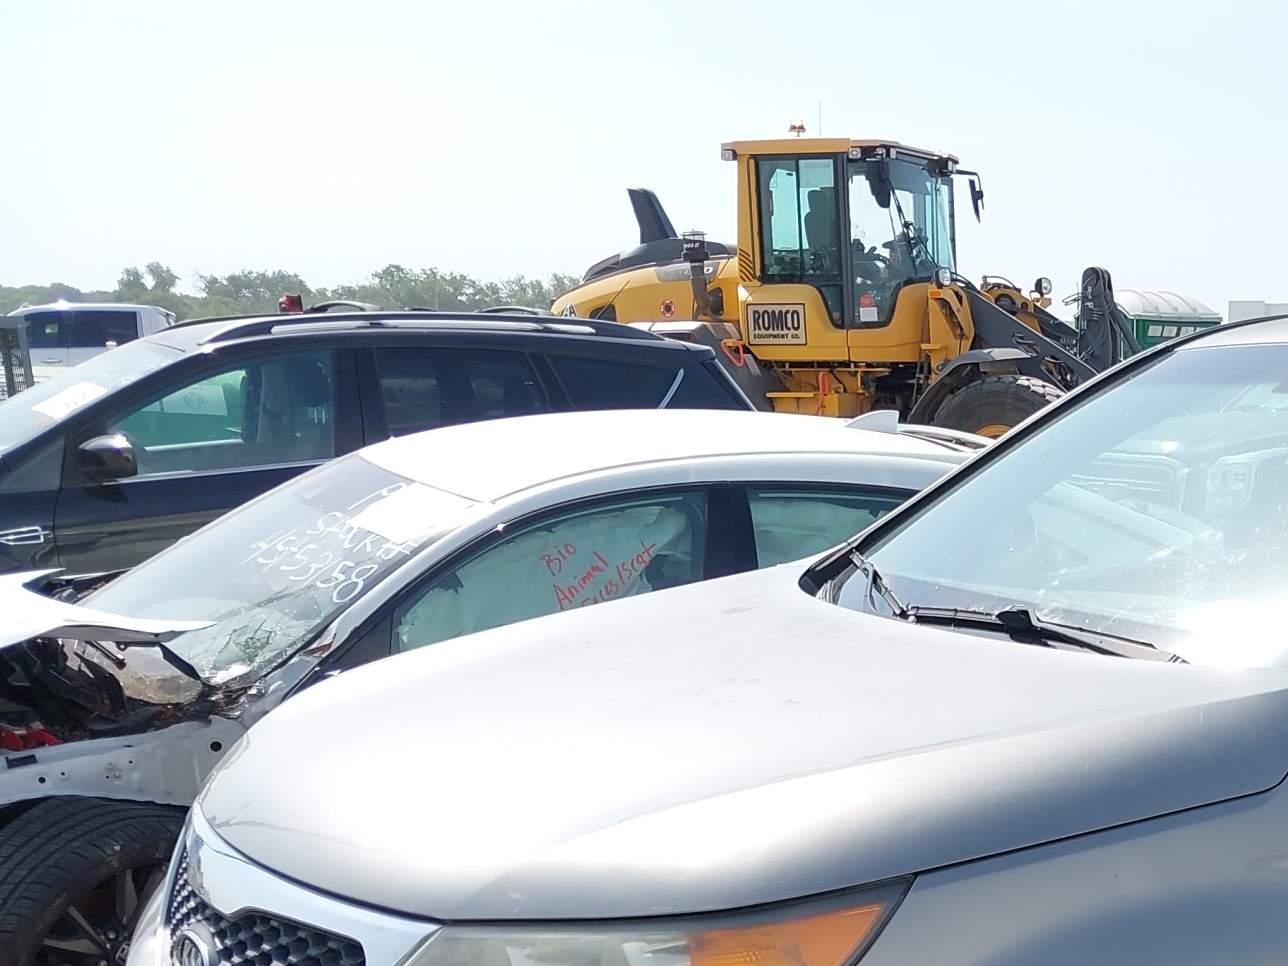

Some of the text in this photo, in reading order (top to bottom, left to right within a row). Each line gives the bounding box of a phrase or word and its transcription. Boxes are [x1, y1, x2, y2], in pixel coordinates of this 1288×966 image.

[752, 309, 801, 331] ROMCO
[540, 543, 577, 577] Bio
[552, 550, 609, 611] Animal
